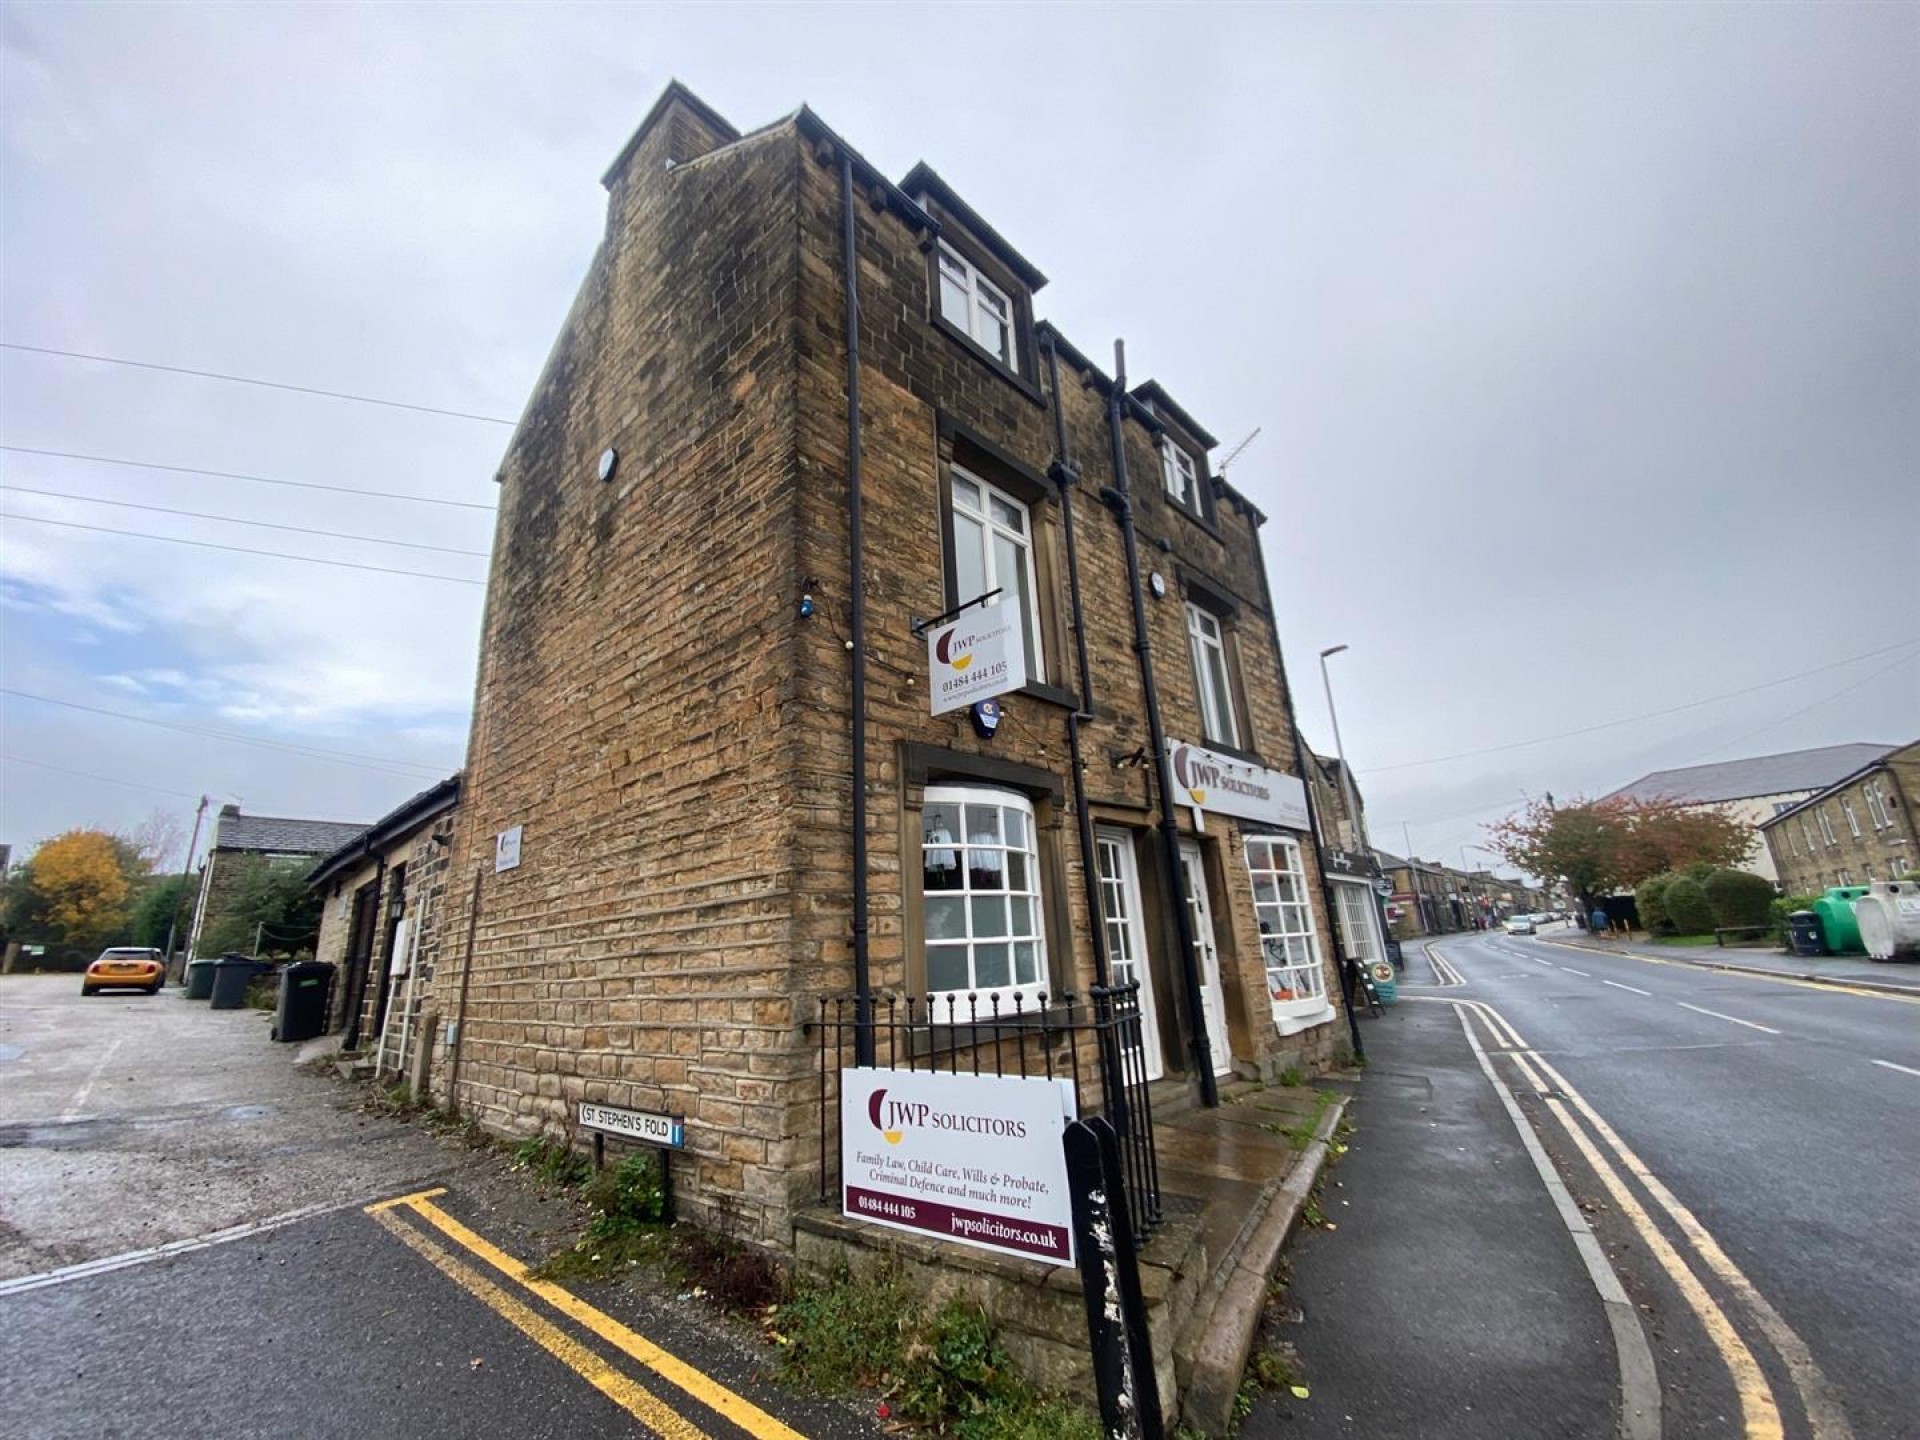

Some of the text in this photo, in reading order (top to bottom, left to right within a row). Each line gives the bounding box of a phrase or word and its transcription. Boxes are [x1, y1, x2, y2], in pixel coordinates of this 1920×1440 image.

[953, 635, 975, 654] JWP
[942, 675, 969, 692] 01484
[971, 668, 988, 681] 444
[991, 661, 1008, 675] 105
[1190, 760, 1220, 789] JWP
[598, 1110, 641, 1132] STEPHEN'S
[644, 1118, 669, 1137] FOLD
[887, 1100, 1027, 1138] JWP SOLICITORS
[856, 1151, 1049, 1195] Family Law, Child Care, Wills & Probate,
[869, 1169, 1031, 1209] Criminal Defence and much more!
[858, 1195, 1058, 1249] 01484 444 105 jwpsolicitors.co.uk
